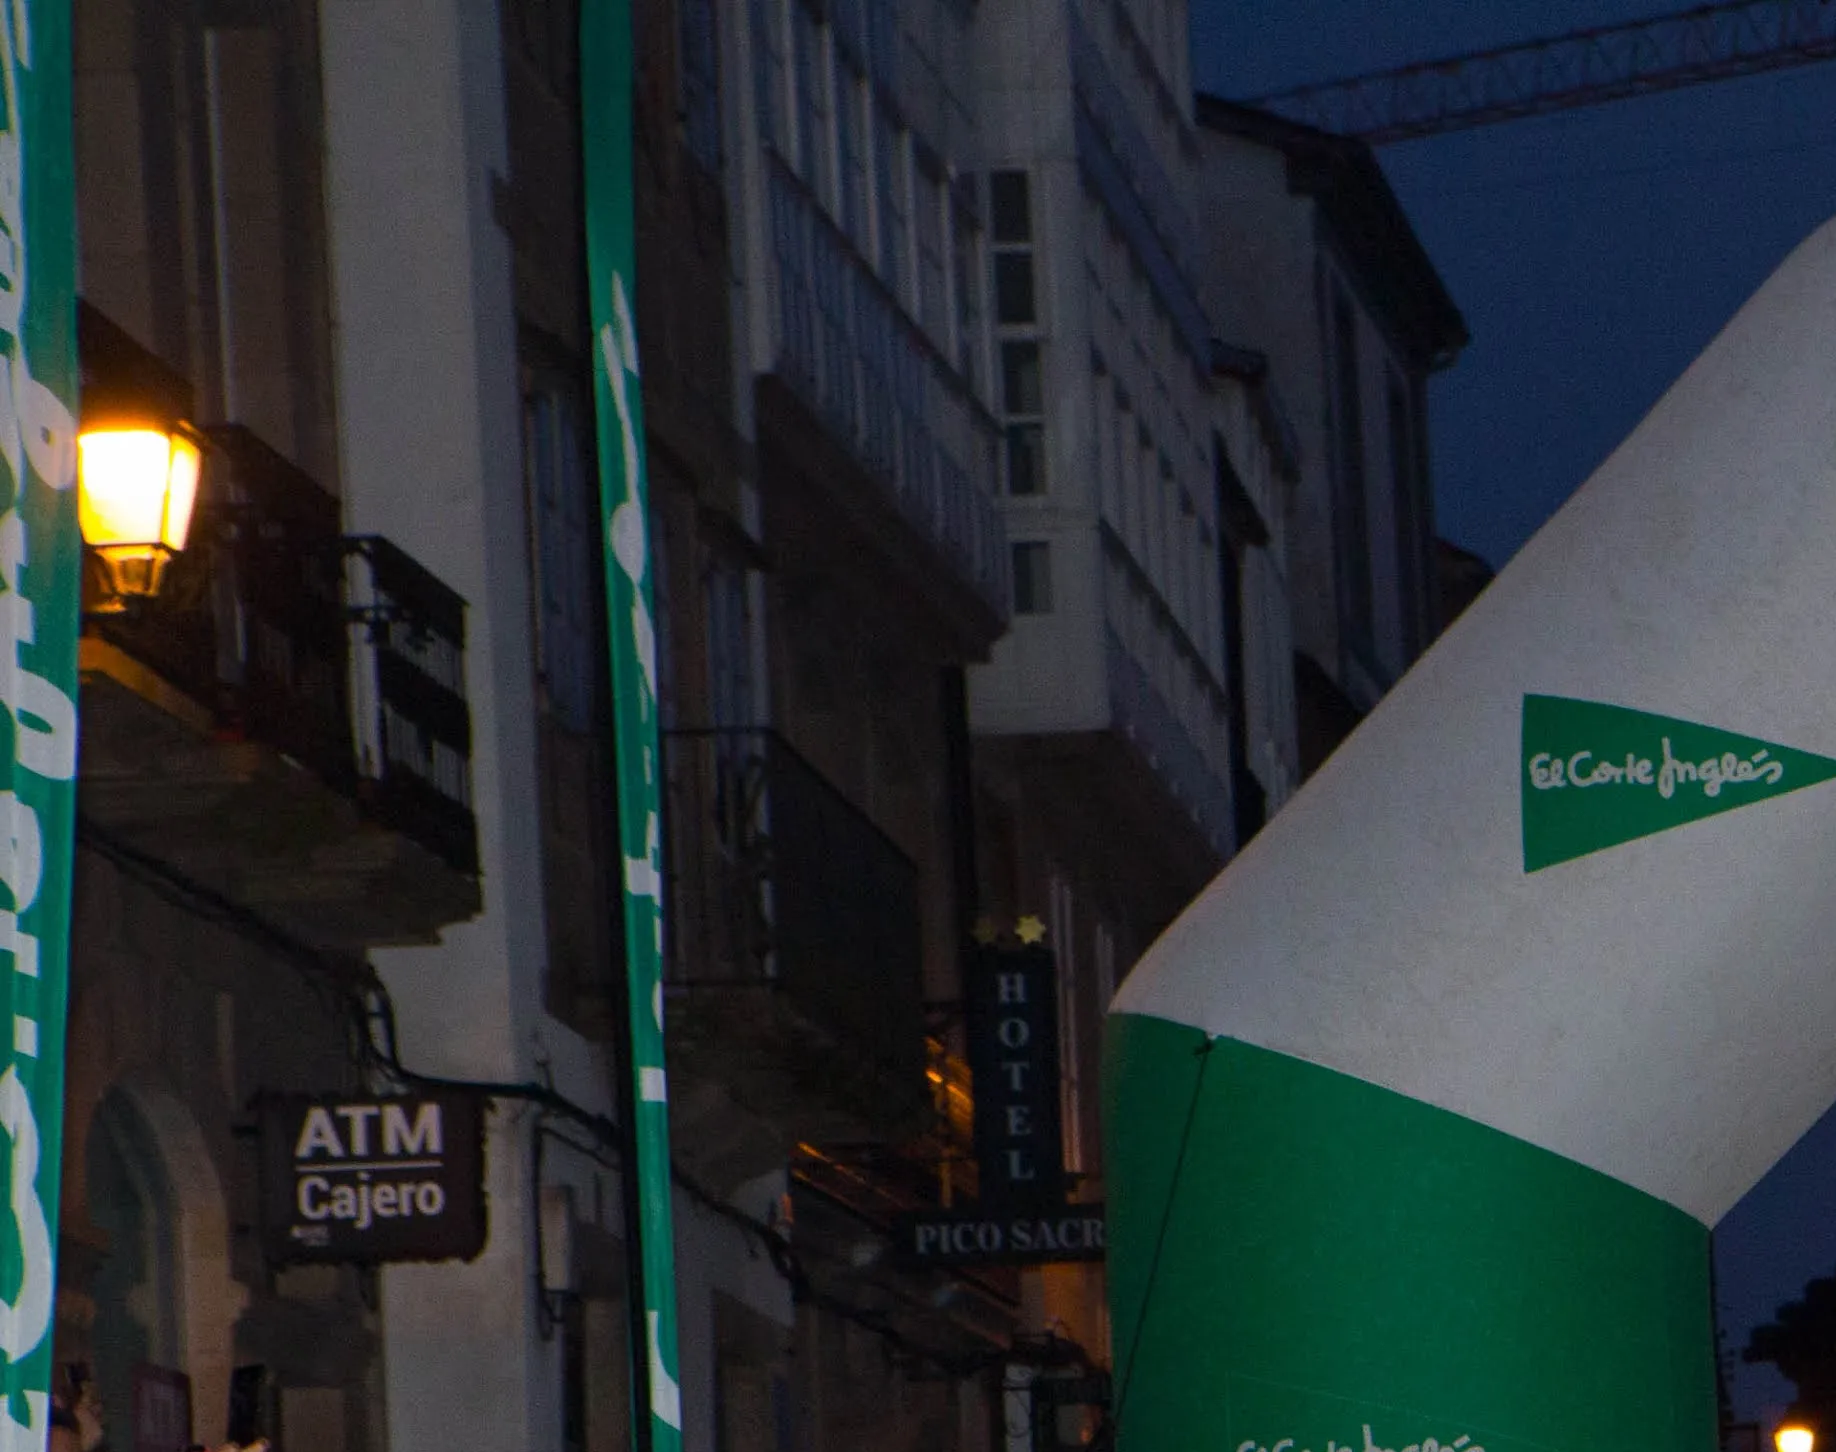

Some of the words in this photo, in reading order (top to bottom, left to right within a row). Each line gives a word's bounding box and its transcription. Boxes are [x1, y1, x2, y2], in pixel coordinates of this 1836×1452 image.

[1529, 752, 1566, 789] El
[1568, 751, 1654, 787] Corte
[1658, 737, 1784, 799] Inglés
[997, 972, 1035, 1180] HOTEL
[295, 1103, 443, 1158] ATM
[297, 1171, 446, 1230] Cajero
[915, 1221, 1002, 1255] PICO
[1010, 1217, 1105, 1251] SACR
